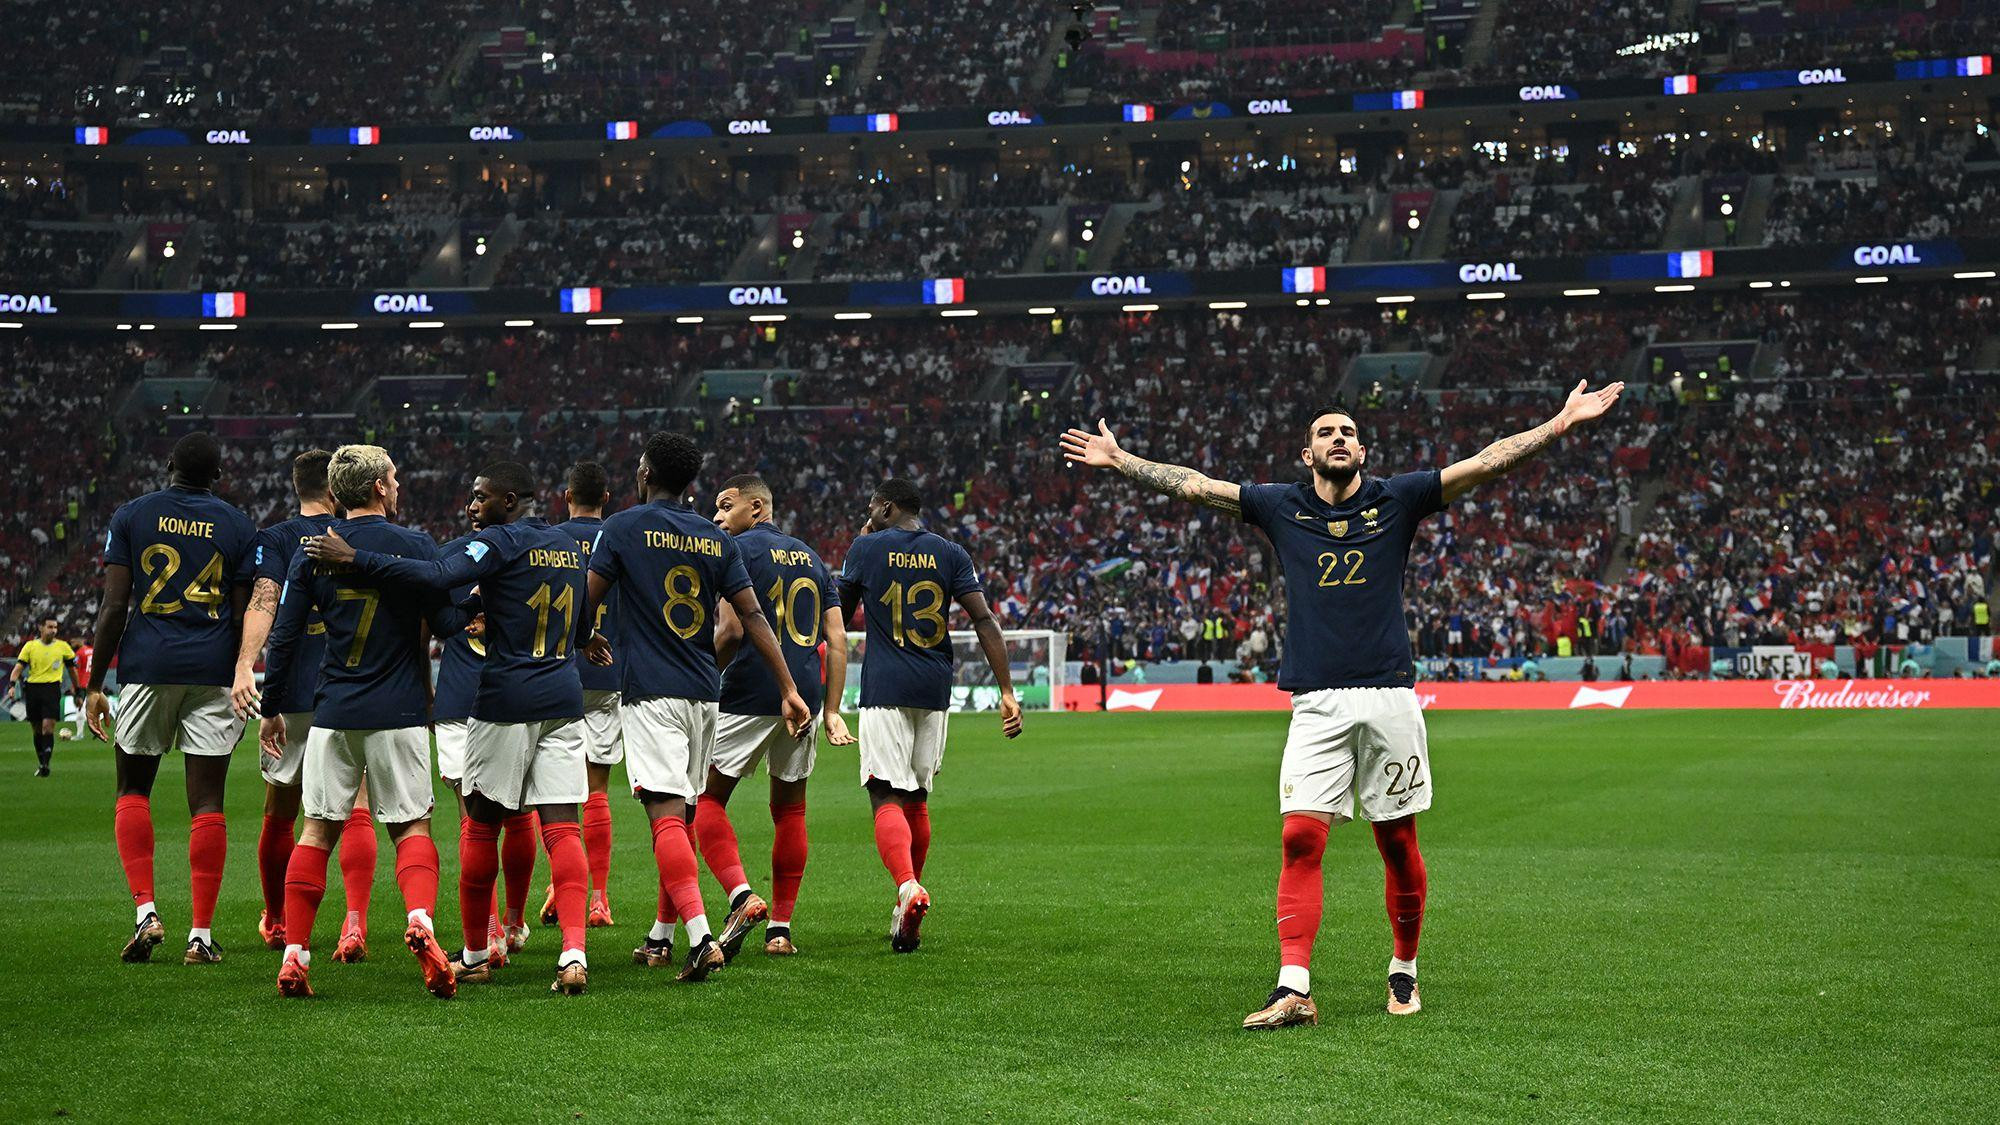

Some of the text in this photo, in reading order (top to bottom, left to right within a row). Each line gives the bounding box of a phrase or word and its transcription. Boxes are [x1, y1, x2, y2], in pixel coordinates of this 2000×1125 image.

[1797, 67, 1847, 85] GOAL
[1518, 84, 1566, 101] GOAL
[1247, 98, 1293, 115] GOAL
[205, 129, 251, 144] GOAL
[469, 126, 515, 141] GOAL
[727, 119, 772, 134] GOAL
[1853, 244, 1922, 266] GOAL
[1458, 262, 1524, 283] GOAL
[728, 286, 789, 306] GOAL
[1090, 275, 1152, 296] GOAL
[373, 294, 434, 314] GOAL
[158, 516, 214, 538] KONATE
[644, 530, 722, 558] TCHOUAMENI
[529, 548, 580, 570] DEMBELE
[770, 548, 813, 568] MBAPPE
[888, 551, 936, 570] FOFANA
[1317, 549, 1367, 588] 22
[140, 543, 225, 620] 24
[662, 564, 705, 640] 8
[767, 575, 821, 647] 10
[526, 581, 574, 660] 11
[879, 579, 947, 649] 13
[336, 588, 381, 667] 7
[1773, 680, 1931, 709] Budweiser
[1384, 755, 1424, 796] 22
